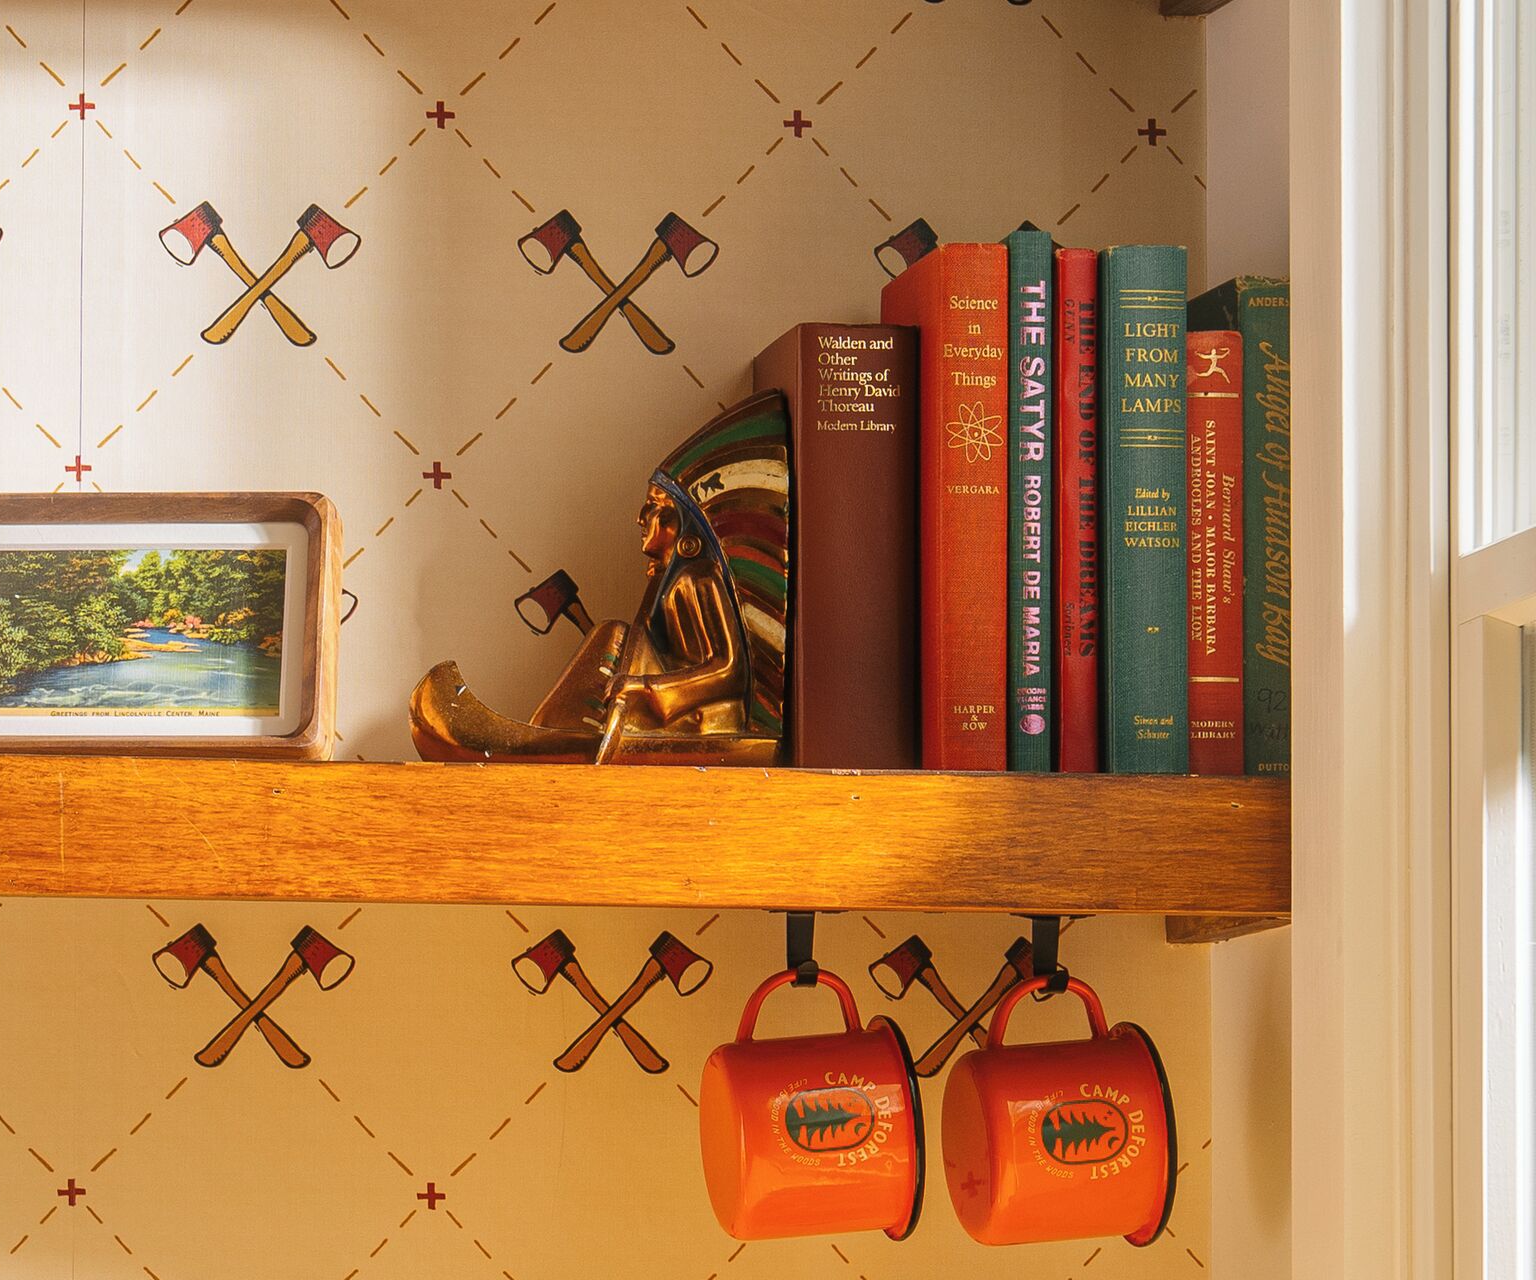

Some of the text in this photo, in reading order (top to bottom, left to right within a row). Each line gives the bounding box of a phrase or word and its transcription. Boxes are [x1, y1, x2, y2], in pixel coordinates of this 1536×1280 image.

[949, 296, 999, 310] Science
[968, 321, 981, 334] in
[1124, 323, 1180, 337] LIGHT
[818, 336, 893, 349] Walden and
[818, 352, 857, 365] Other
[944, 344, 1004, 360] Everyday
[1125, 348, 1179, 363] FROM
[818, 368, 890, 385] Writings of
[1019, 280, 1046, 462] THE SATYR
[951, 371, 997, 388] Things
[1124, 373, 1180, 388] MANY
[819, 384, 900, 400] Henry David
[818, 400, 874, 412] Thoreau
[1121, 398, 1182, 413] LAMPS
[817, 420, 896, 434] Modern Library
[947, 485, 1000, 495] VERGARA
[1135, 487, 1171, 502] Edited by
[1127, 505, 1177, 517] LILLIAN
[1023, 475, 1042, 563] ROBERT
[1125, 521, 1177, 532] EICHLER
[1124, 537, 1181, 548] WATSON
[1191, 434, 1202, 642] ANDROCLES AND THE LION
[1205, 420, 1217, 656] SAINT JOAN MAJOR BARBARA
[1222, 472, 1236, 605] Bernard Shaw's
[1023, 570, 1041, 599] DE
[1023, 606, 1041, 676] MARIA
[954, 705, 996, 714] HARPER
[962, 721, 988, 731] ROW
[1190, 731, 1236, 739] LIBRARY
[825, 1072, 893, 1167] CAMP DEFOREST
[1080, 1084, 1146, 1180] CAMP DEFOREST
[777, 1137, 792, 1155] THE
[791, 1154, 821, 1166] WOODS
[1028, 1137, 1036, 1146] IN
[1033, 1149, 1047, 1166] THE
[1046, 1165, 1073, 1178] WOODS
